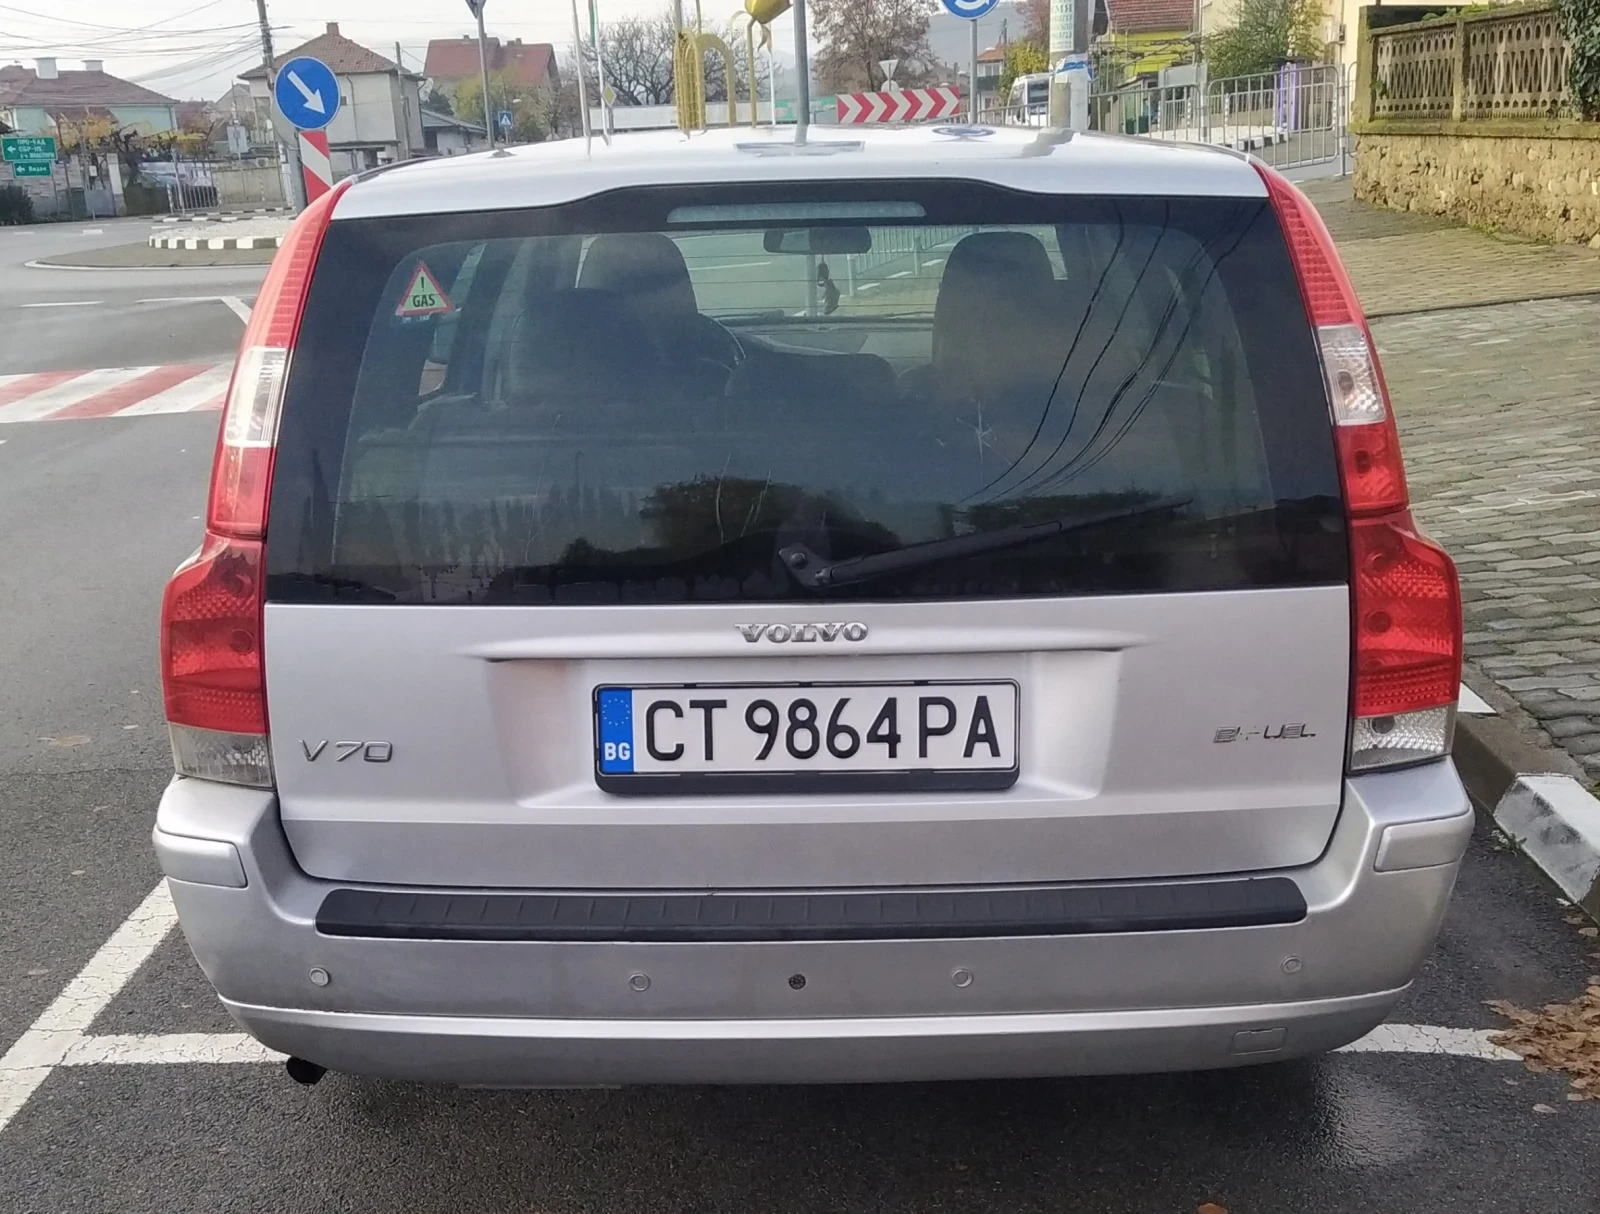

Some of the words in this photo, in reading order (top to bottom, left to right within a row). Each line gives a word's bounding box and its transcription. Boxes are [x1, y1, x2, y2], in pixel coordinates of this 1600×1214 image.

[412, 294, 436, 308] GAS
[734, 621, 869, 644] VOLVO
[744, 697, 902, 762] 9864
[604, 741, 631, 762] BG
